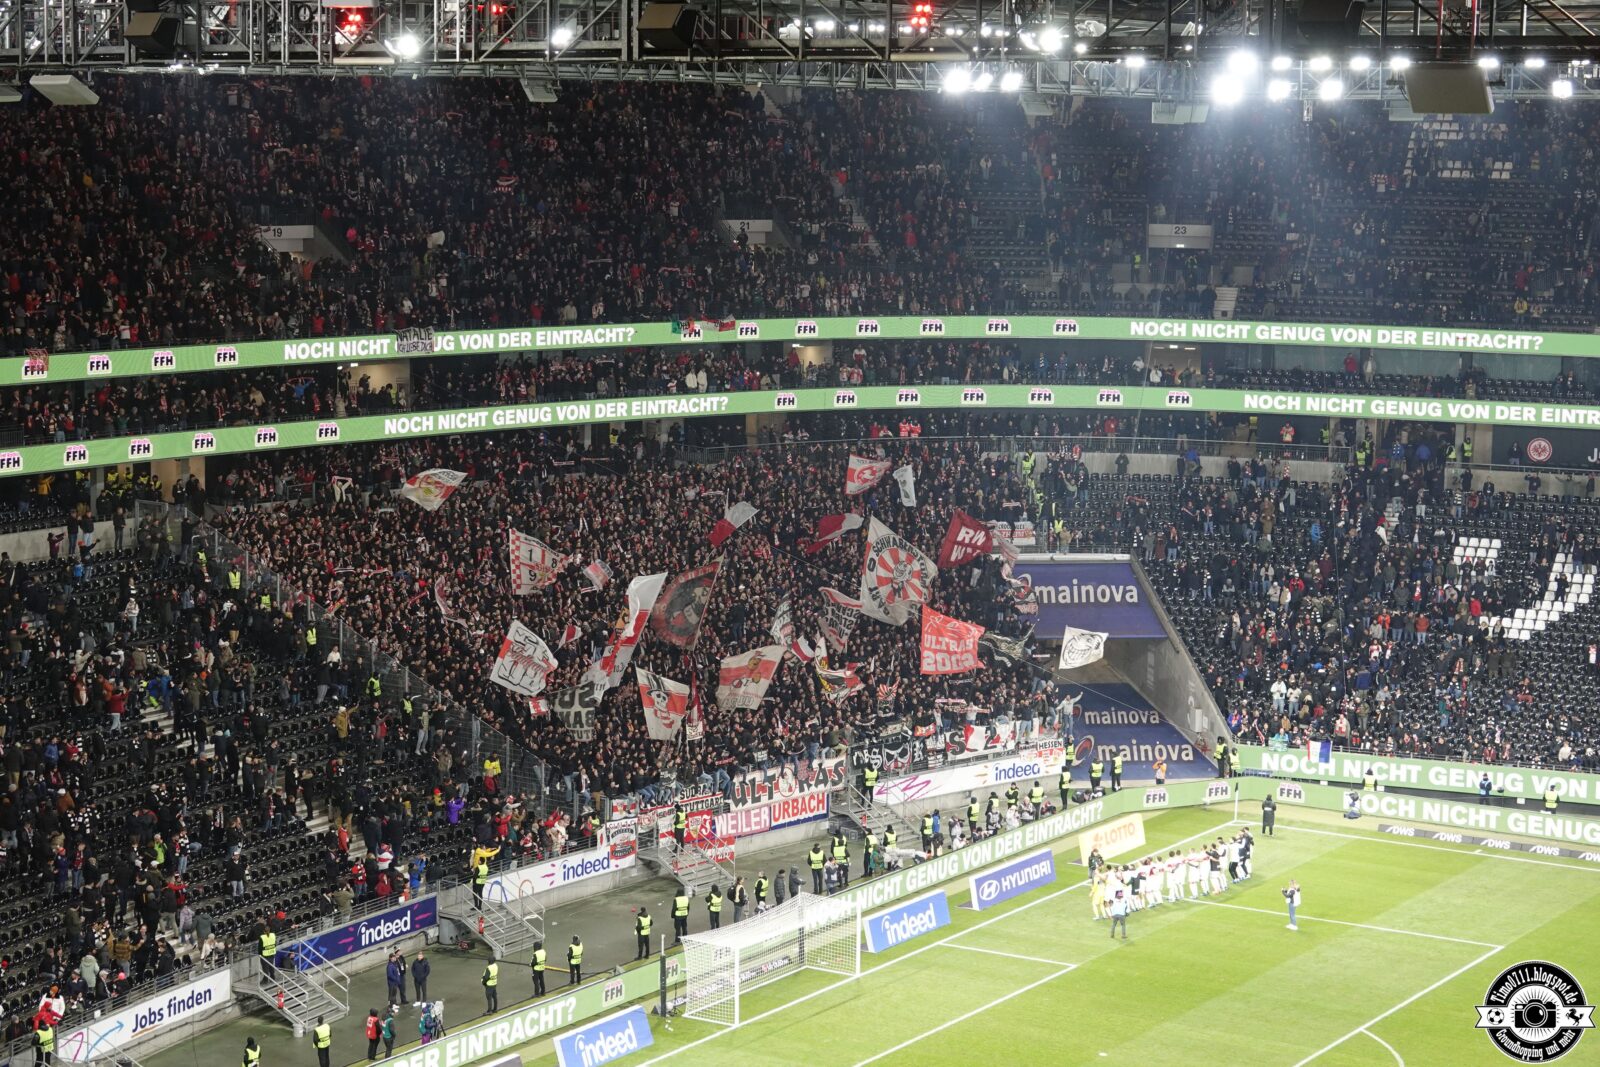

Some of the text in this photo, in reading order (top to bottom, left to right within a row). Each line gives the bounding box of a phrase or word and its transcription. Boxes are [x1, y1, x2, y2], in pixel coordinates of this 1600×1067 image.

[272, 218, 282, 237] 19
[740, 222, 750, 230] 21
[1174, 226, 1186, 234] 23
[740, 327, 757, 335] FFH
[1056, 324, 1076, 332] FFH
[1131, 322, 1543, 350] NOCH NICHT GENUG VON DER EINTRACHT?
[285, 342, 334, 359] NOCH
[339, 339, 390, 356] NICHT
[460, 334, 494, 349] VON
[499, 332, 531, 347] DER
[536, 327, 634, 346] EINTRACHT?
[154, 356, 173, 366] FFH
[217, 352, 235, 362] FFH
[90, 360, 109, 371] FFH
[777, 397, 794, 406] FFH
[837, 395, 854, 403] FFH
[964, 393, 983, 401] FFH
[1031, 393, 1051, 401] FFH
[1100, 394, 1120, 402] FFH
[1245, 395, 1300, 410] NOCH
[1306, 397, 1365, 413] NICHT
[1371, 400, 1442, 416] GENUG
[1448, 403, 1489, 419] VON
[1496, 406, 1536, 421] DER
[385, 396, 729, 434] NOCH NICHT GENUG VON DER EINTRACHT?
[258, 433, 275, 443] FFH
[319, 428, 337, 437] FFH
[195, 438, 213, 448] FFH
[131, 444, 150, 455] FFH
[67, 450, 85, 461] FFH
[1, 457, 20, 468] FFH
[1033, 579, 1138, 603] mainova
[924, 634, 974, 650] ULTRAS
[1084, 706, 1160, 724] mainova
[1038, 740, 1062, 750] HESSEN
[1098, 739, 1194, 761] mainova
[1262, 752, 1587, 798] NOCH NICHT GENUG VON
[1209, 786, 1228, 797] FFH
[1280, 788, 1301, 799] FFH
[1146, 793, 1165, 803] FFH
[772, 793, 826, 822] URBACH
[714, 806, 770, 836] WEILER
[1422, 801, 1501, 829] NICHT
[1507, 813, 1600, 845] GENUG
[1105, 822, 1136, 845] LOTTO
[1393, 826, 1415, 836] DWS
[1440, 833, 1462, 843] DWS
[906, 852, 958, 890] GENUG
[962, 840, 992, 868] VON
[998, 824, 1022, 854] DER
[1026, 804, 1103, 842] EINTRACHT?
[1488, 839, 1511, 850] DWS
[1537, 846, 1560, 856] DWS
[562, 852, 610, 881] indeed
[1002, 862, 1051, 893] HYUNDAI
[362, 911, 410, 945] indeed
[885, 904, 936, 944] indeed
[605, 985, 622, 1001] FFH
[132, 987, 212, 1034] Jobs finden
[446, 997, 576, 1067] EINTRACHT?
[581, 1020, 638, 1067] indeed
